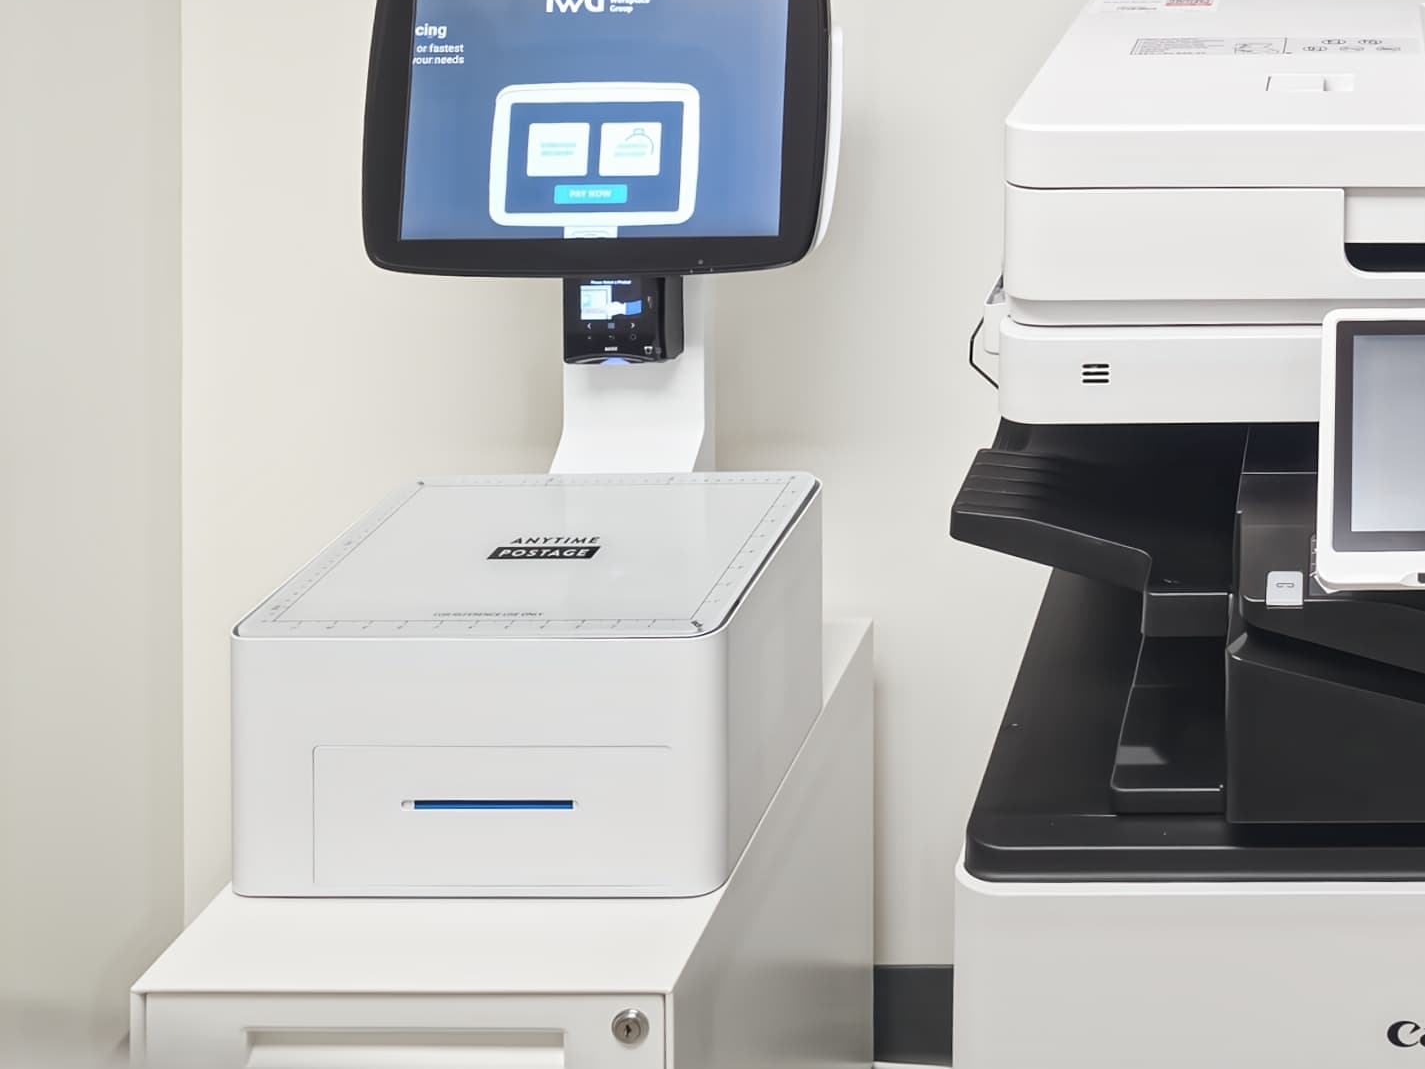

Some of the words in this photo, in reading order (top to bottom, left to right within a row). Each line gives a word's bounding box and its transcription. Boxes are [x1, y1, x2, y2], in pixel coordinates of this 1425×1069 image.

[609, 5, 633, 14] Group
[417, 45, 427, 53] or
[429, 44, 464, 53] fastest
[435, 55, 464, 65] needs
[569, 189, 586, 198] PAY
[589, 189, 612, 198] NOW
[510, 536, 600, 544] ANYTIME
[499, 549, 590, 557] POSTAGE
